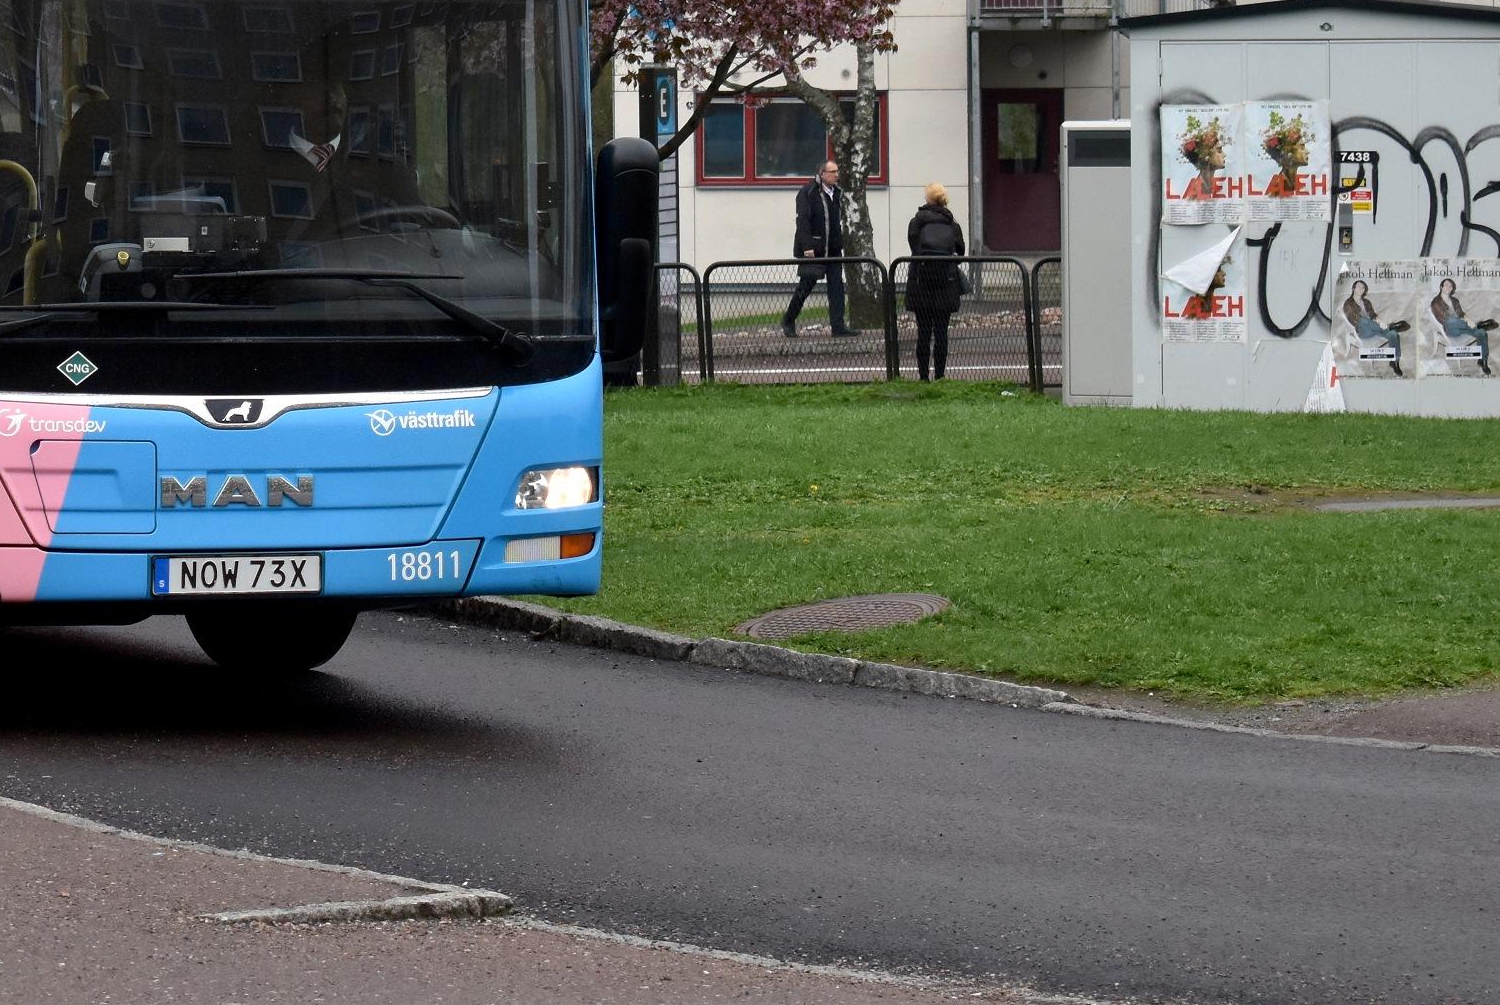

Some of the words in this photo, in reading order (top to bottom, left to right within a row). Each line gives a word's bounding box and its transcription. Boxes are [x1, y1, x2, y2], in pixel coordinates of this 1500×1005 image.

[660, 88, 667, 117] E
[1340, 152, 1370, 162] 7438
[1165, 177, 1244, 200] LALEH
[1248, 174, 1328, 198] LALEH
[1424, 265, 1453, 277] Jakob
[1164, 296, 1244, 318] LALEH
[66, 363, 90, 374] CNG
[28, 416, 106, 433] transdev
[398, 408, 476, 429] västtrafik
[160, 474, 314, 508] MAN
[158, 580, 165, 588] S
[180, 560, 240, 589] NOW
[250, 560, 307, 588] 73X
[388, 550, 460, 581] 18811
